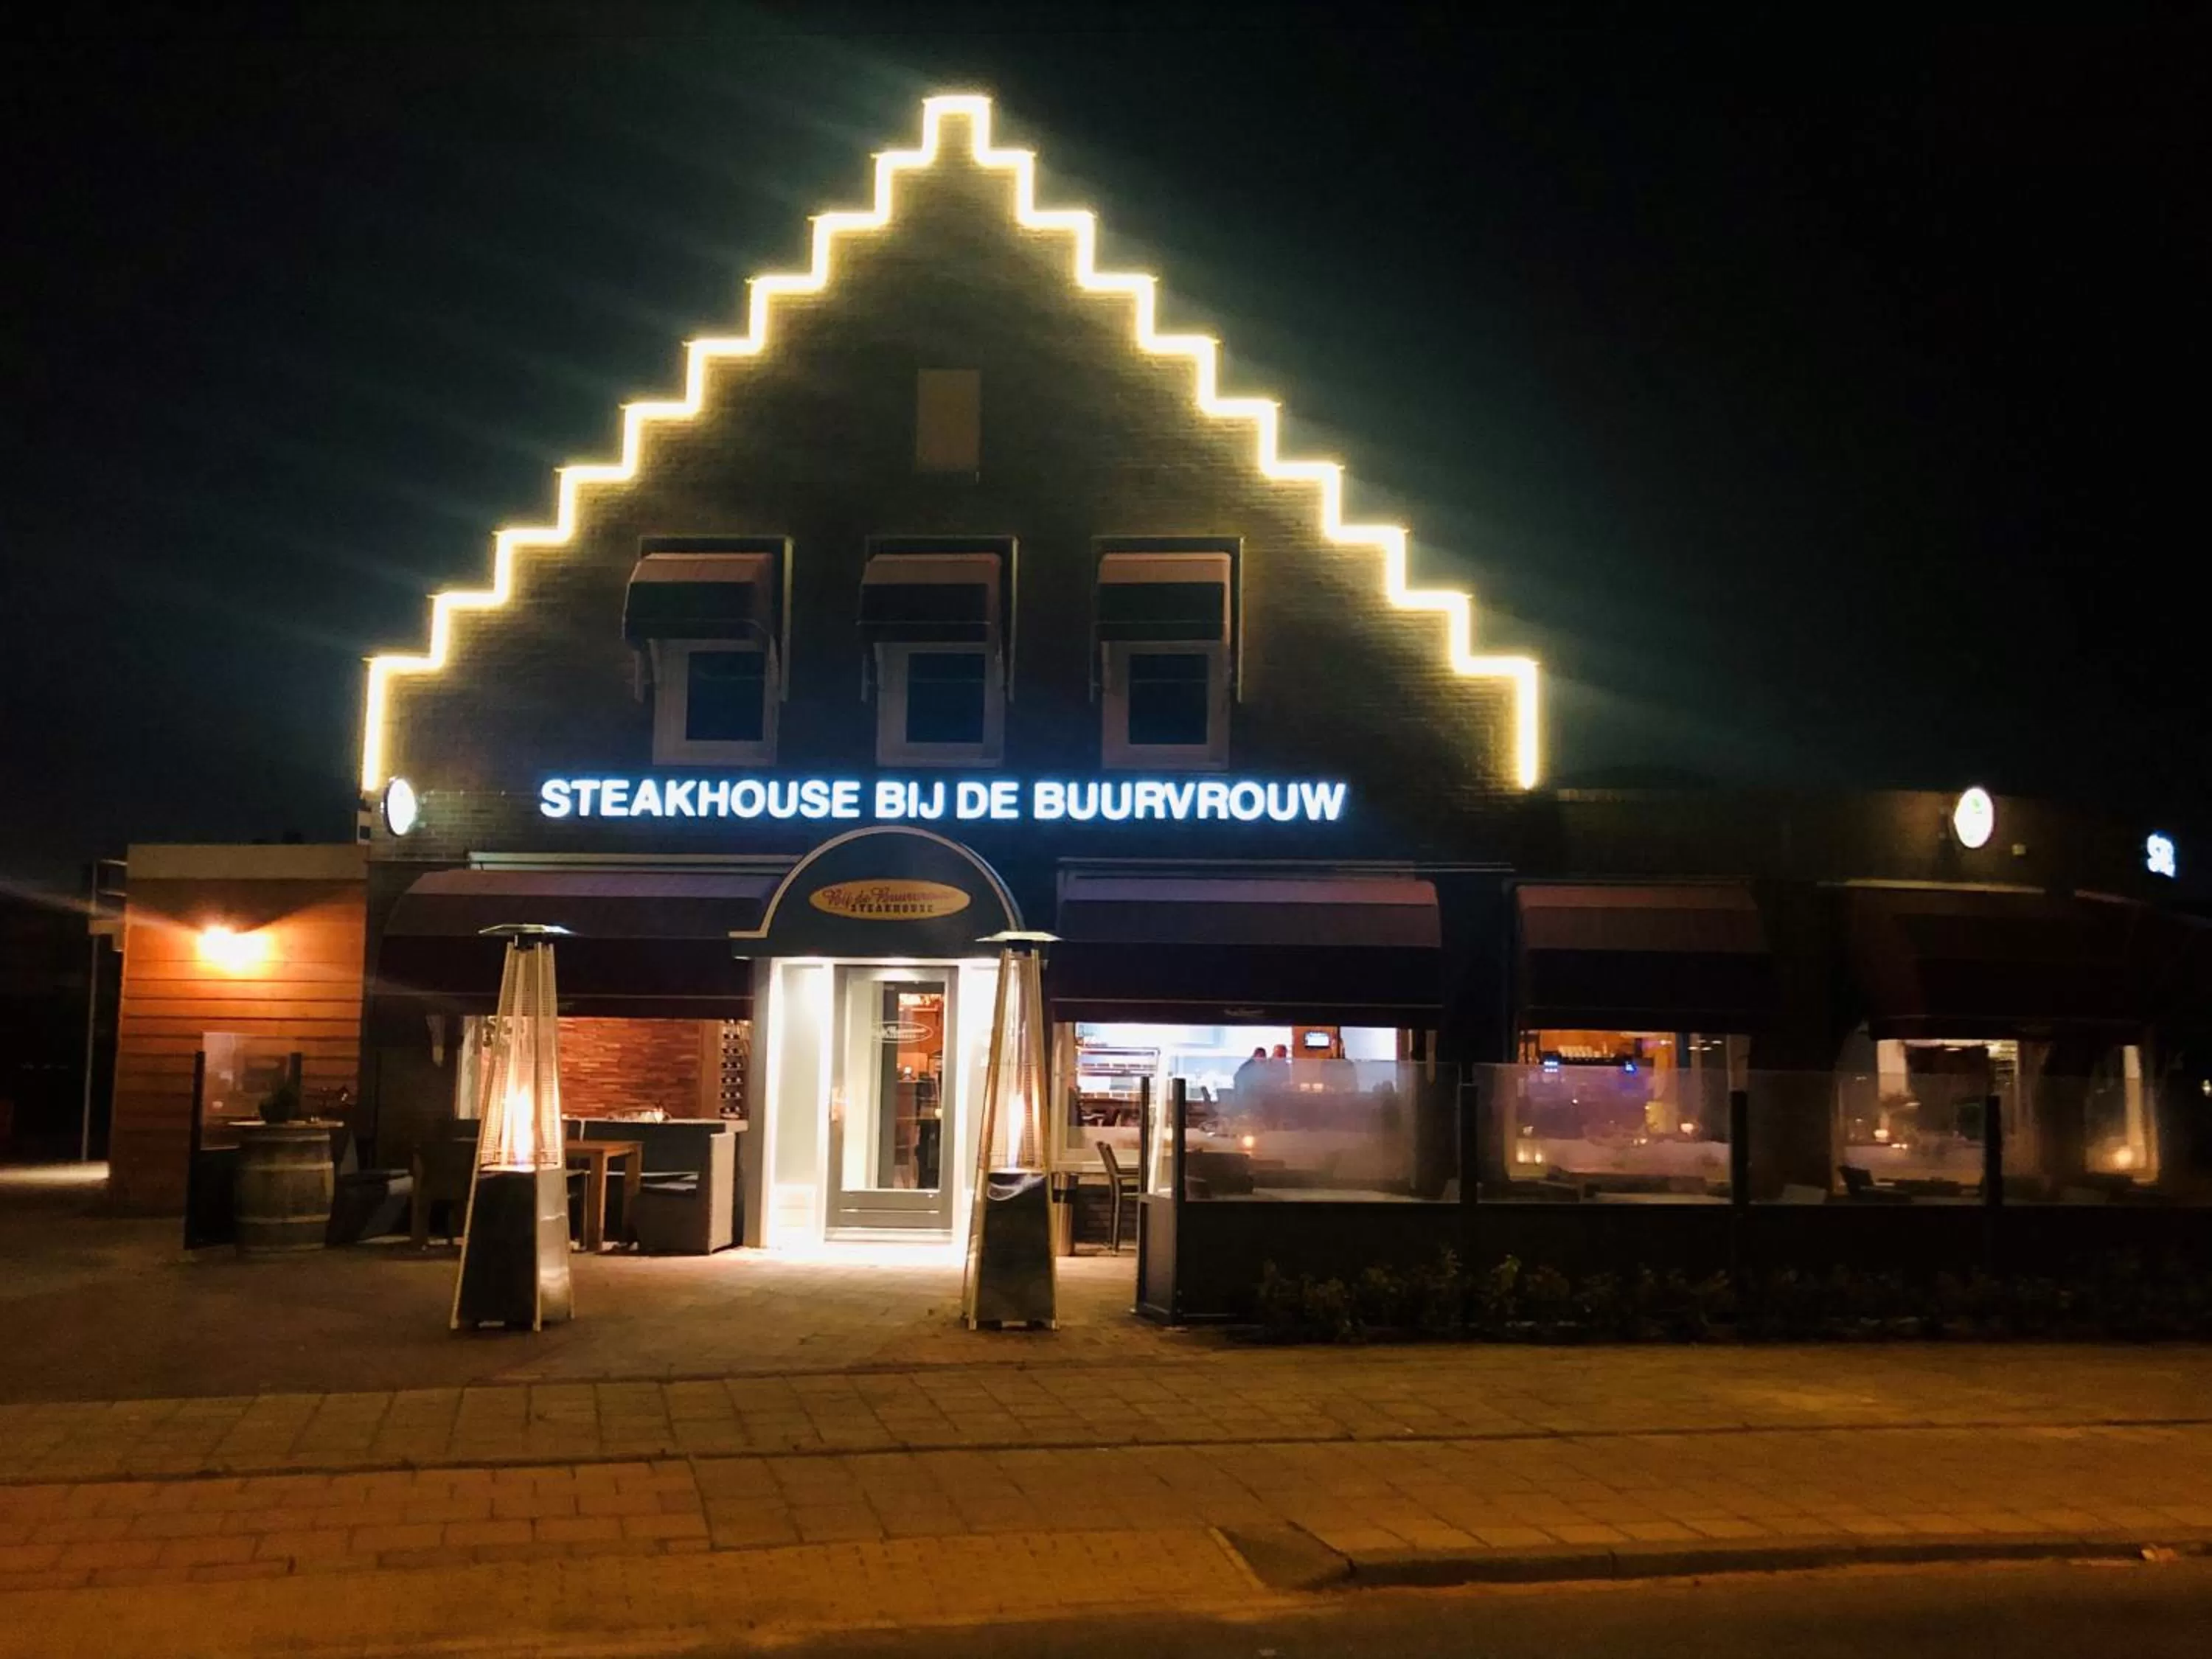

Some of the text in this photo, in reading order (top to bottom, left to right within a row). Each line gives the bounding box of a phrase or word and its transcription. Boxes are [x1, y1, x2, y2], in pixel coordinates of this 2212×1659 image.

[540, 779, 1346, 821] STEAKHOUSE BIJ DE BUURVROUW
